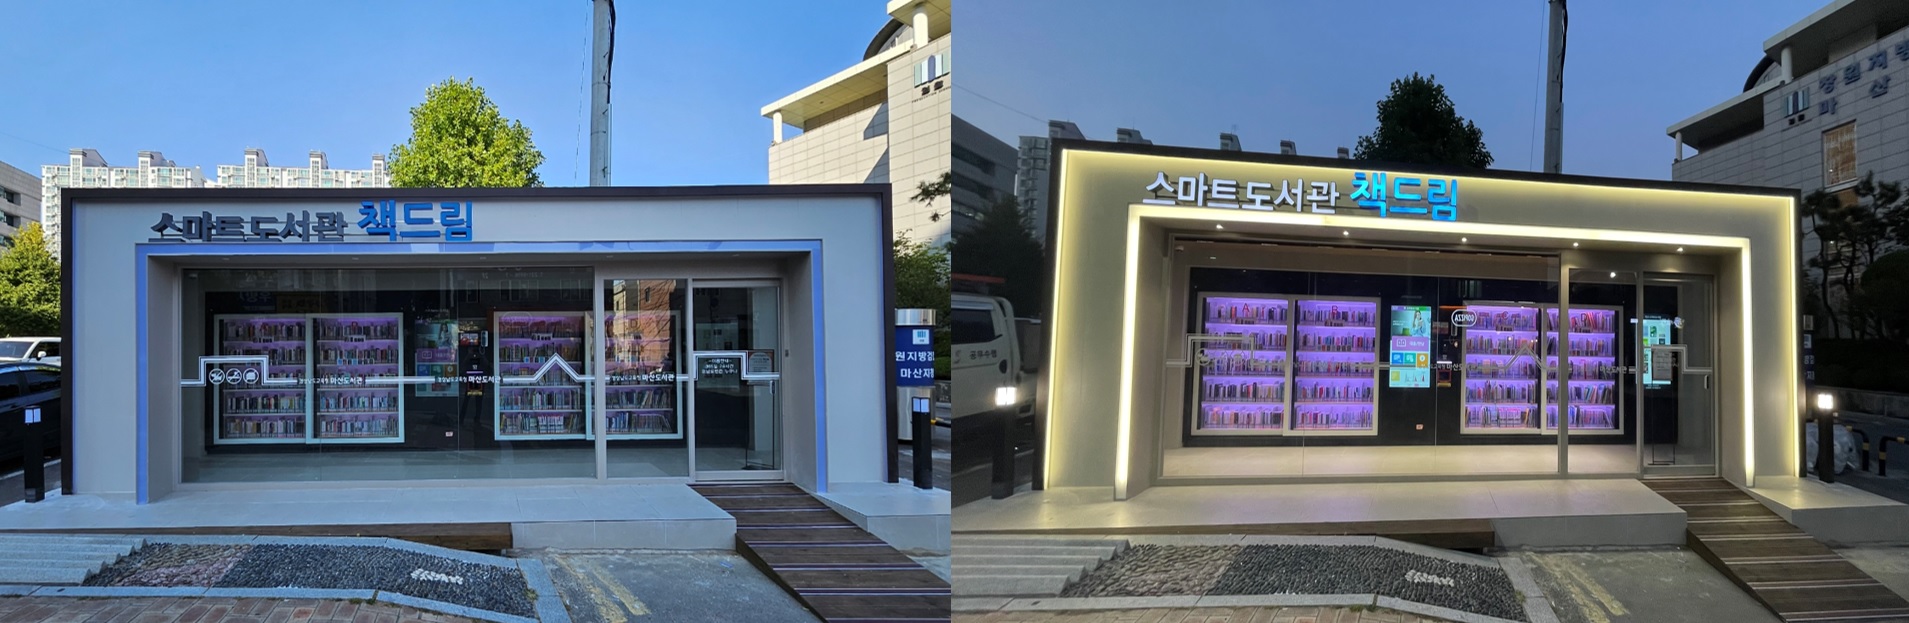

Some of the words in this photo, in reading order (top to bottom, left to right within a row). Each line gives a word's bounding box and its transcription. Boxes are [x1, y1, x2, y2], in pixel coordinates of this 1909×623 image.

[1143, 171, 1340, 214] 스마트도서관
[1350, 171, 1458, 222] 책드림
[148, 209, 348, 242] 스마트도서관
[357, 200, 473, 242] 책드림
[970, 349, 997, 360] 공무수행
[330, 375, 363, 385] 마산도서관
[468, 375, 501, 384] 마산도서관
[642, 373, 675, 382] 마산도서관
